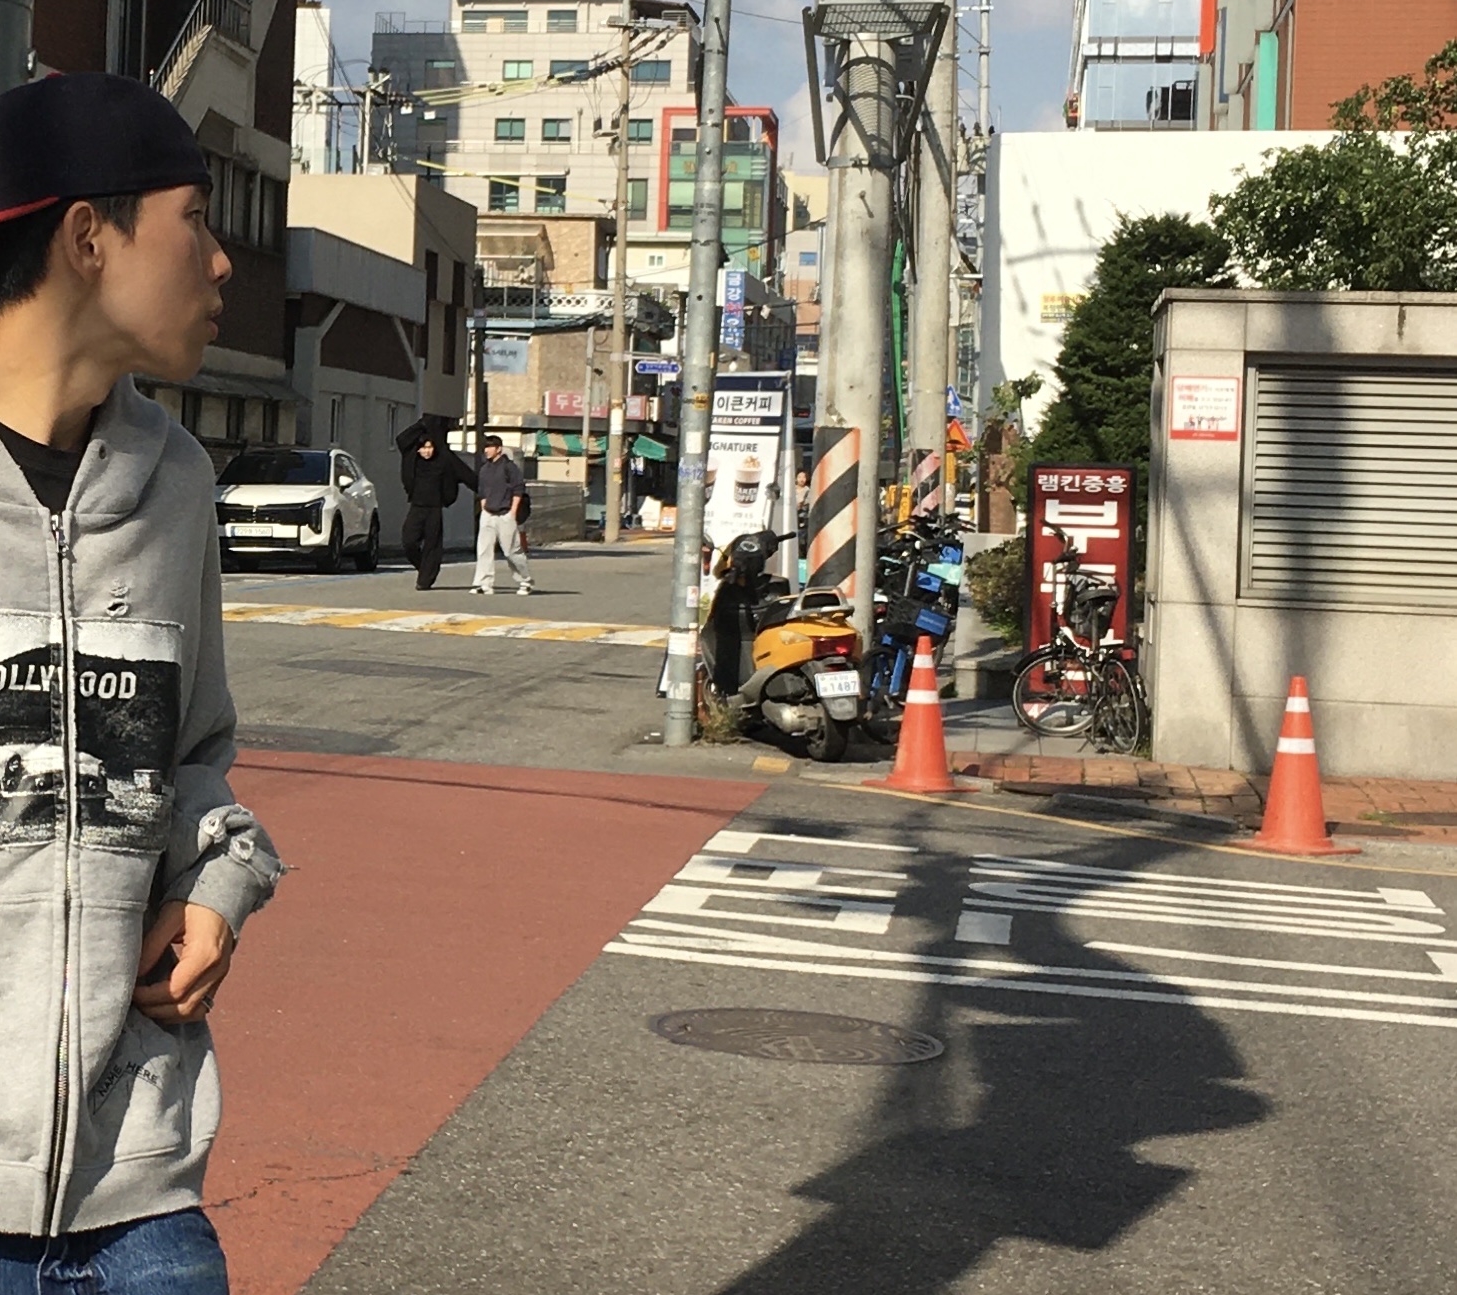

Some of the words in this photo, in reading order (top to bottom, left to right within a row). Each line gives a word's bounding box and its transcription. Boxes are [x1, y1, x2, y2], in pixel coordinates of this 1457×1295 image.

[716, 395, 772, 412] 이큰커피
[734, 417, 761, 425] COFFEE
[709, 441, 758, 452] IGNATURE
[830, 681, 857, 693] 1487
